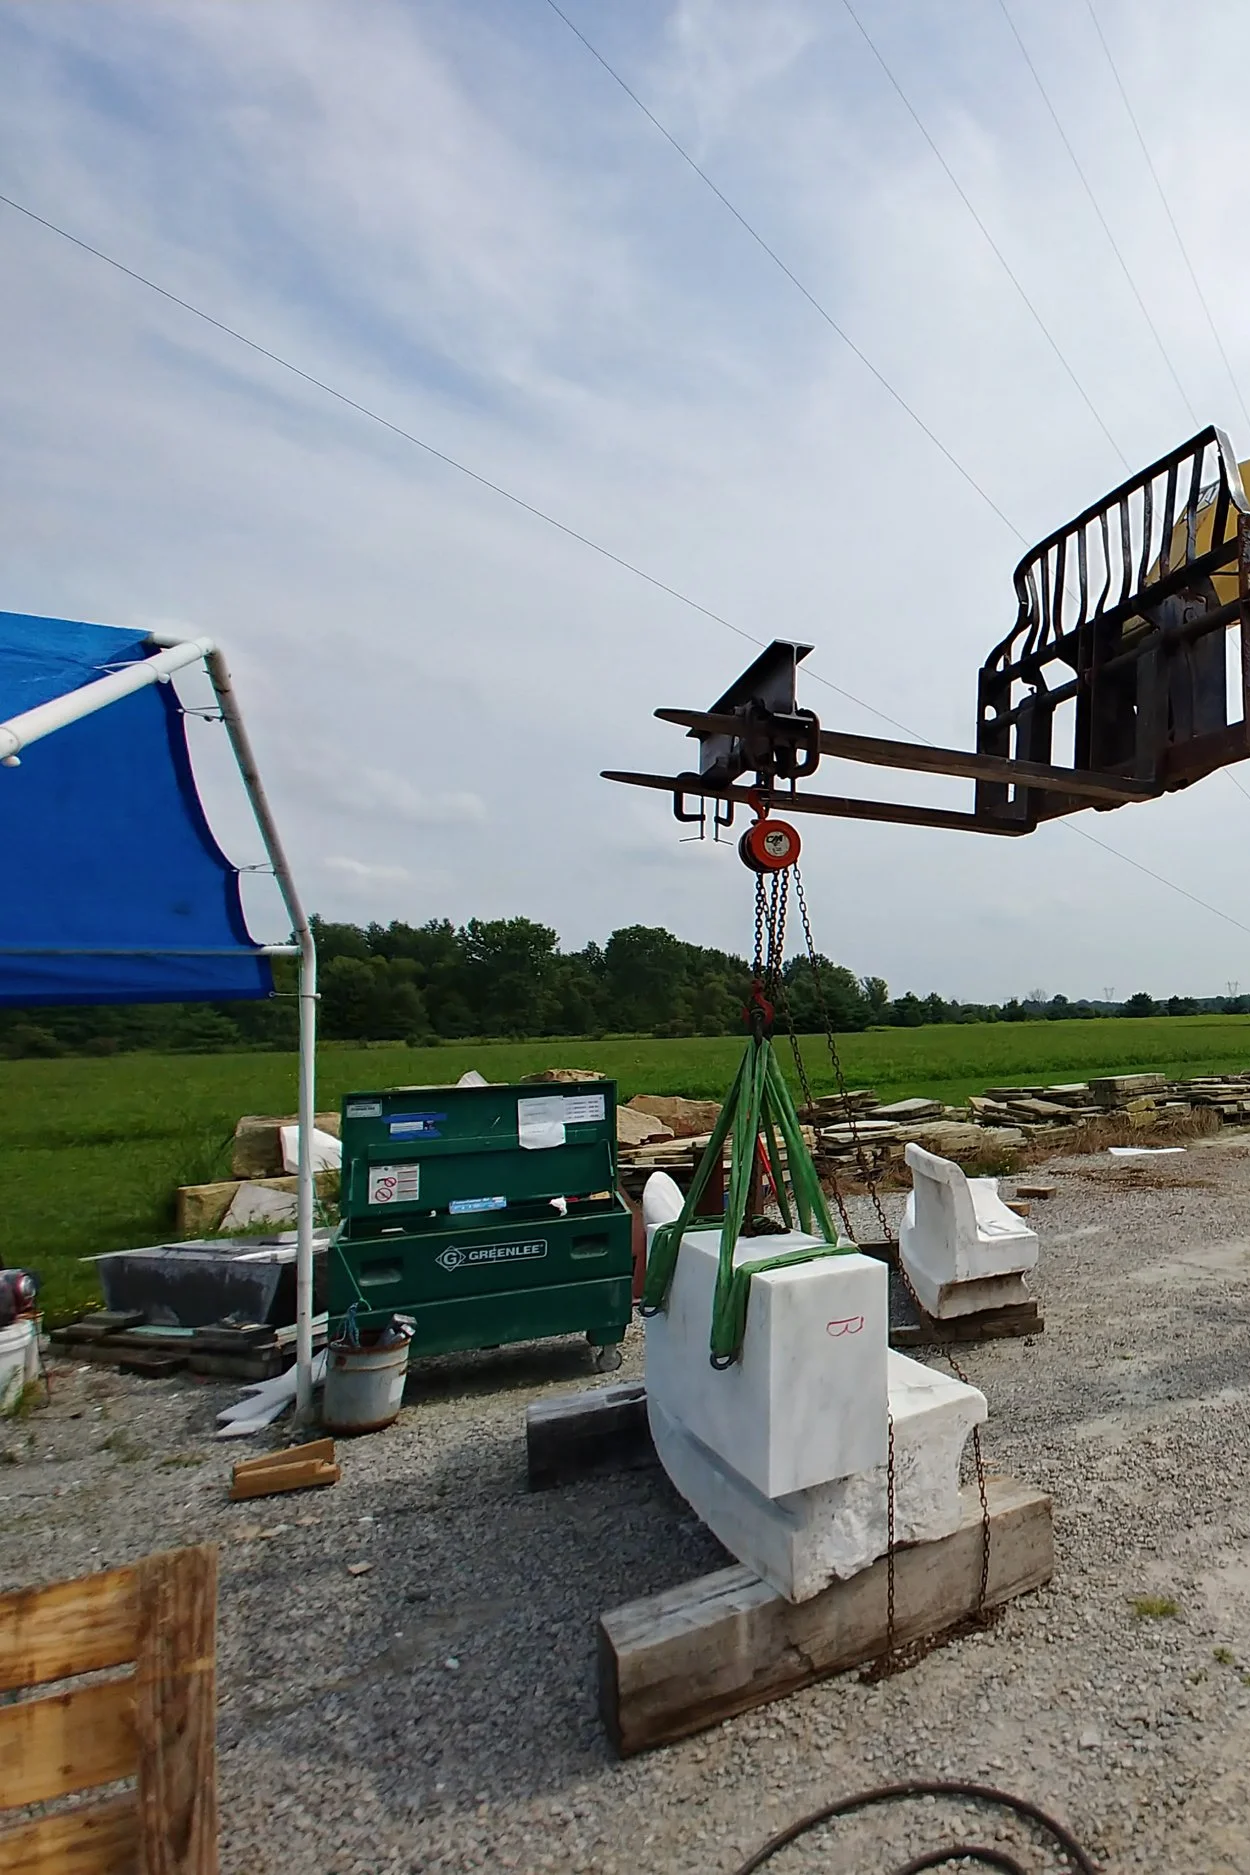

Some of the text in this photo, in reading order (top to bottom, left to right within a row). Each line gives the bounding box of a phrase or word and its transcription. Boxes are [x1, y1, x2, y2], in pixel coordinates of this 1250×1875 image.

[443, 1245, 540, 1265] G GREENLEE
[826, 1316, 864, 1337] B
